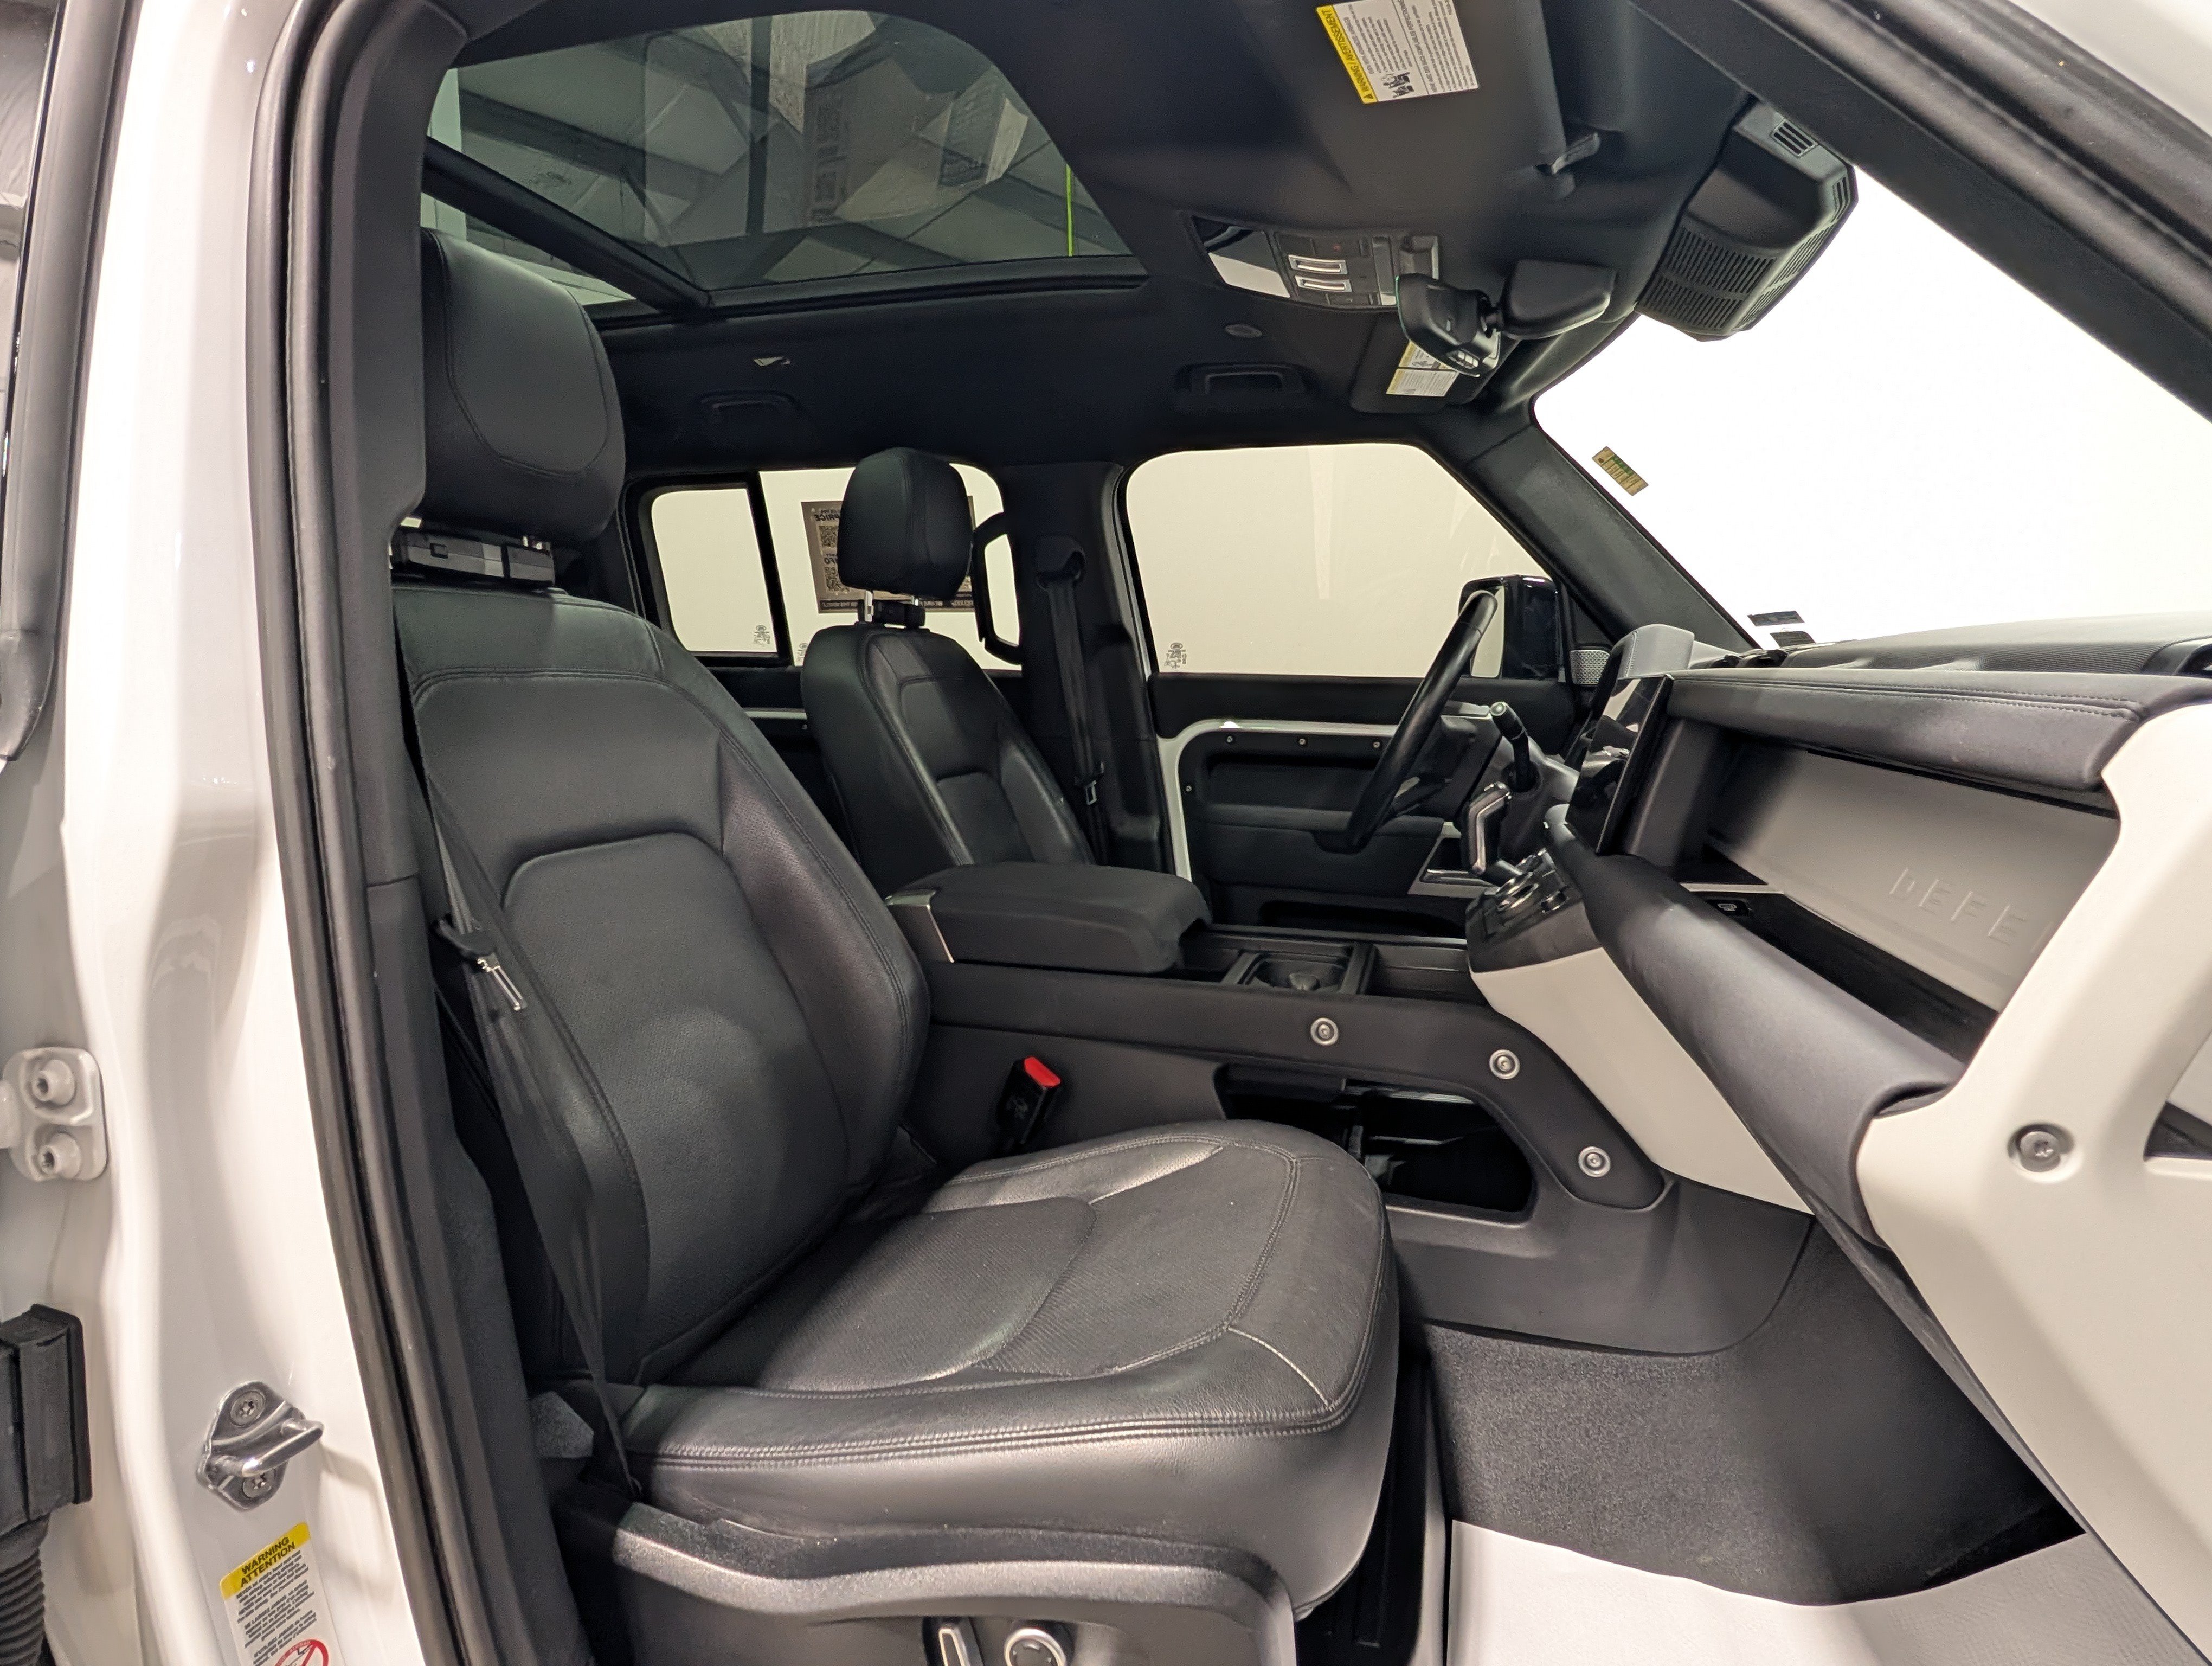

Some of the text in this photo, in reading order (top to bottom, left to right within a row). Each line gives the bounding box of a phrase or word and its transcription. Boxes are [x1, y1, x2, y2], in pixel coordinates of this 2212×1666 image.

[1889, 867, 2054, 954] DEFE
[240, 1541, 295, 1587] ATTENTION
[241, 1536, 290, 1574] WARNING
